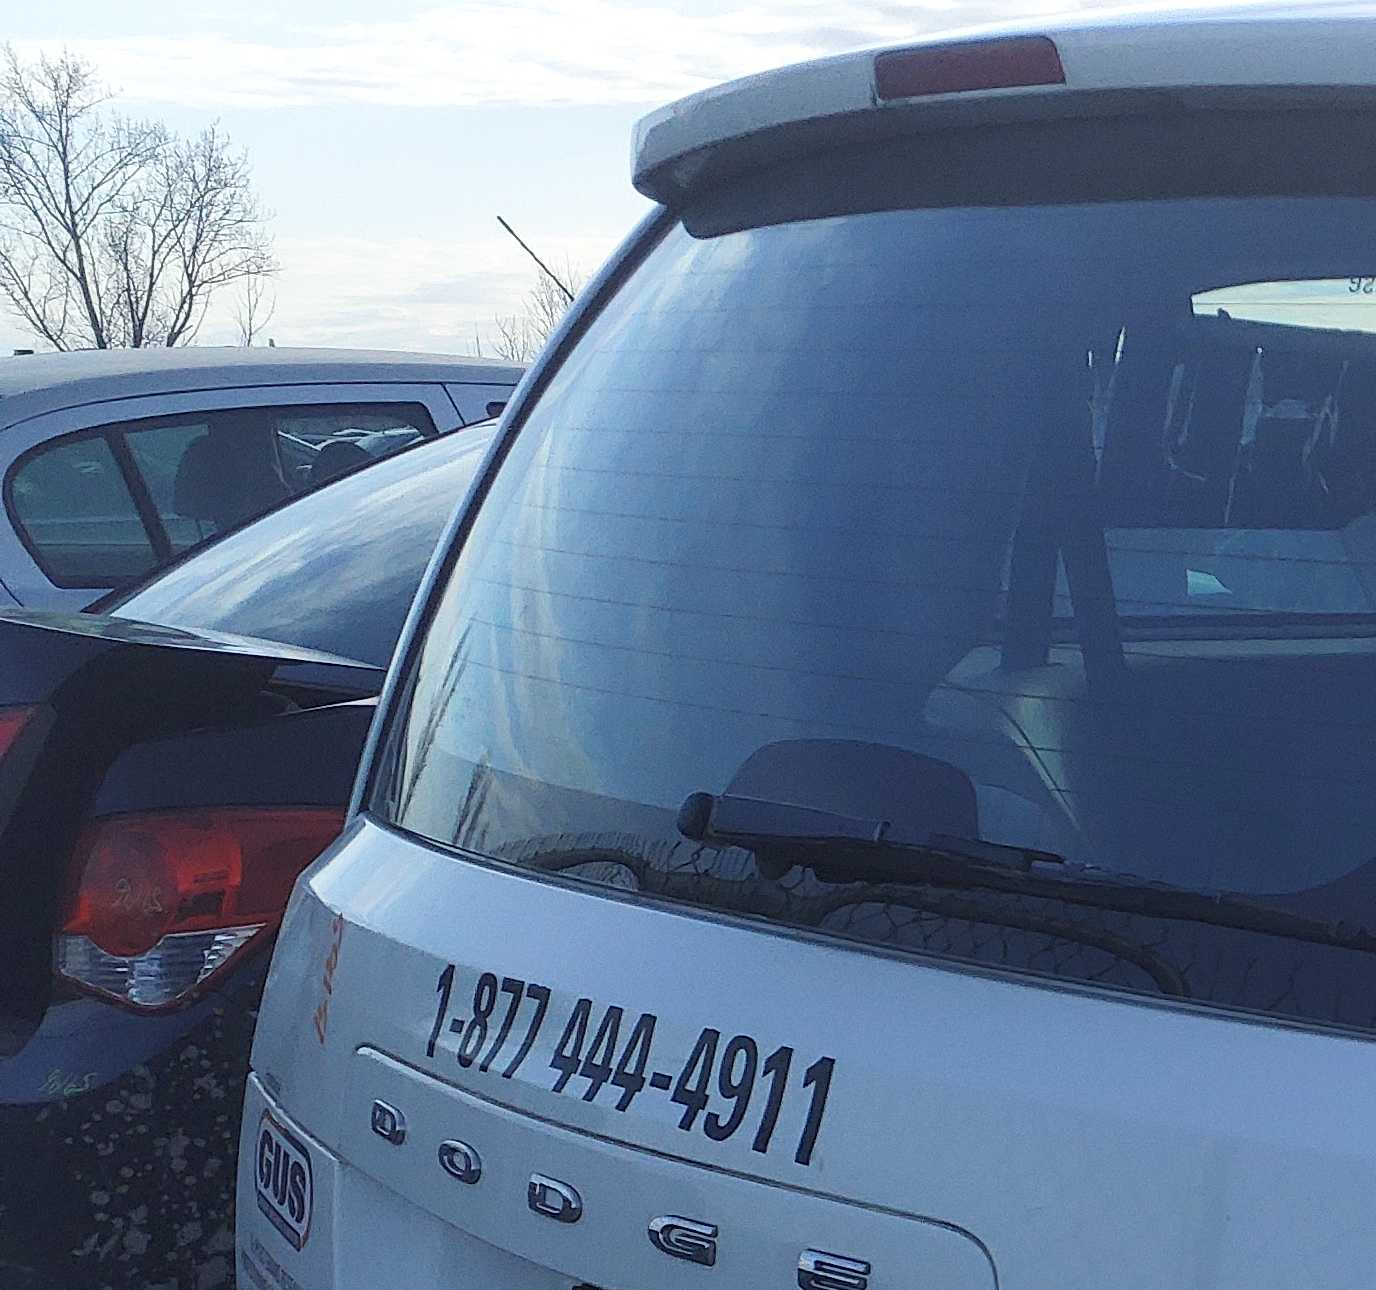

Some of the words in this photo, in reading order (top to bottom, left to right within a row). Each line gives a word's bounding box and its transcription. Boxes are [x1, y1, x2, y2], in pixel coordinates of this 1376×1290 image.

[426, 964, 552, 1079] 1-877
[549, 998, 837, 1166] 444-4911
[259, 1129, 306, 1224] GUS
